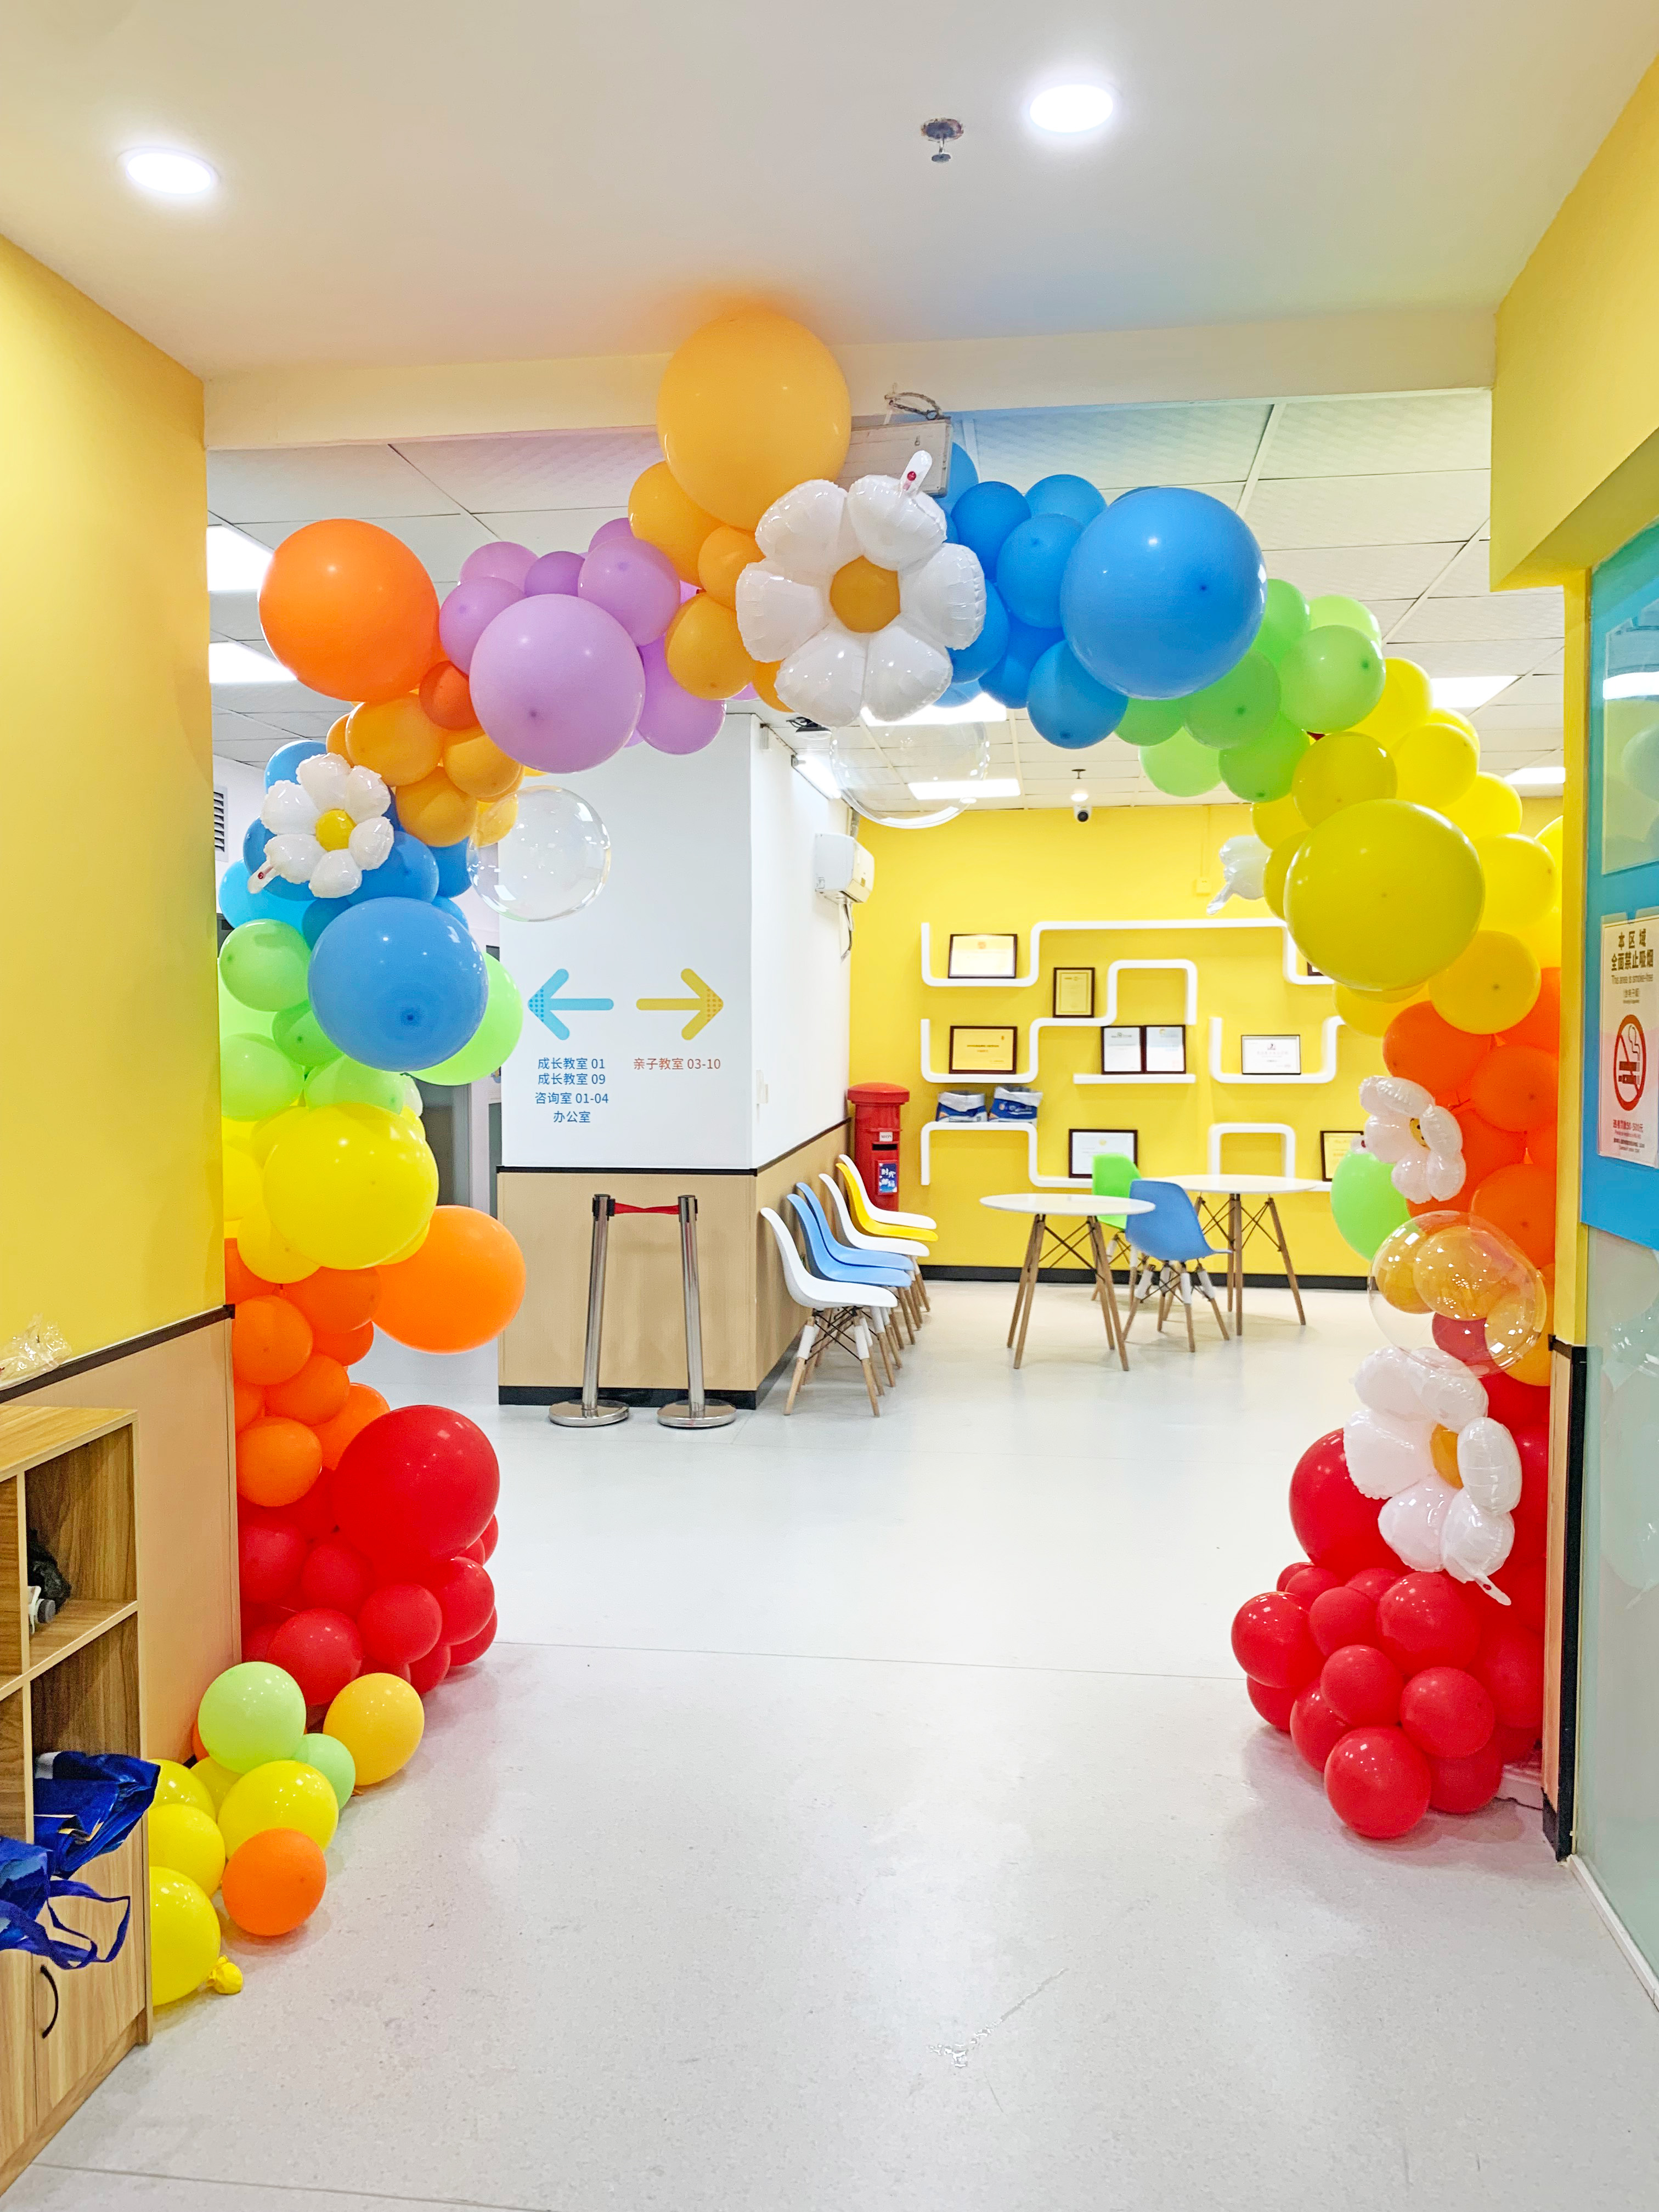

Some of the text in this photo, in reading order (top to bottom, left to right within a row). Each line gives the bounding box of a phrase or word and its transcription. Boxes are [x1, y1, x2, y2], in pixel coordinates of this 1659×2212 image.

[1618, 928, 1646, 951] 本区域
[538, 1057, 605, 1070] 成长教室 01
[633, 1057, 721, 1070] 亲子教室 03-10
[538, 1073, 606, 1085] 成长教室 09
[534, 1091, 610, 1104] 咨询室 01-04
[553, 1110, 591, 1123] 办公室
